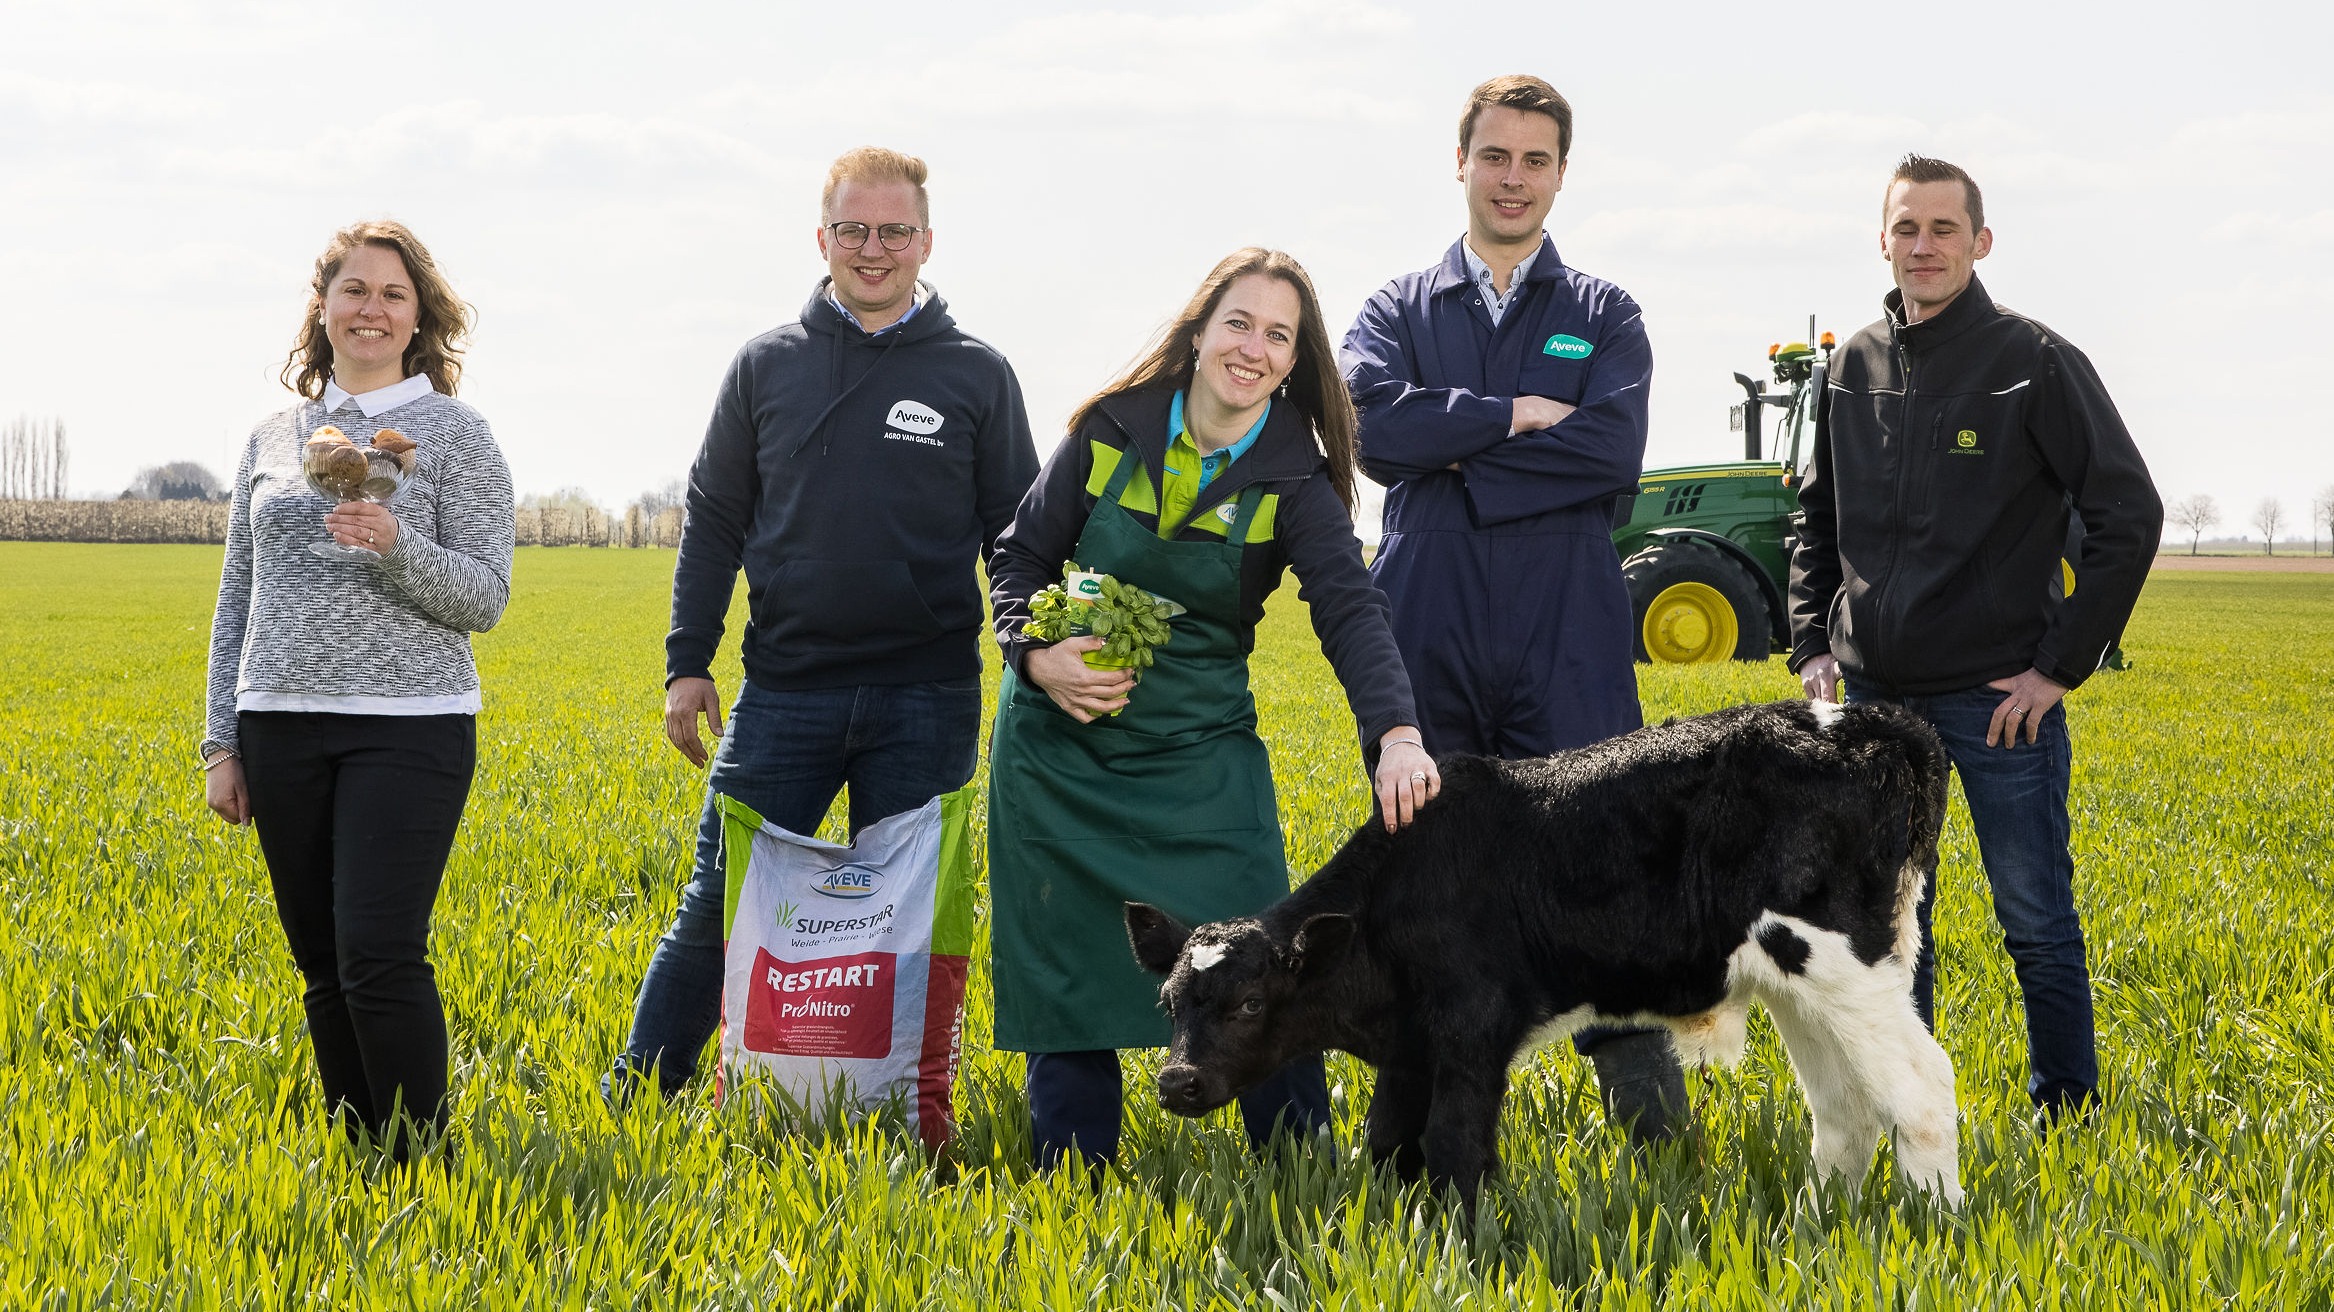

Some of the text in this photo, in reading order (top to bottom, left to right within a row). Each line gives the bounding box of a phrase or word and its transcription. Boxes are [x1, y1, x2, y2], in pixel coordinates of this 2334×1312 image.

[1550, 341, 1586, 353] Aveve
[895, 409, 935, 425] Aveve
[884, 432, 901, 440] AGRO
[902, 434, 915, 442] VAN
[915, 436, 937, 446] GASTEL
[823, 872, 871, 890] AVEVE
[795, 904, 894, 934] SUPERSTAR
[791, 938, 820, 948] Weide
[828, 934, 859, 944] Prairie
[766, 964, 880, 993] RESTART
